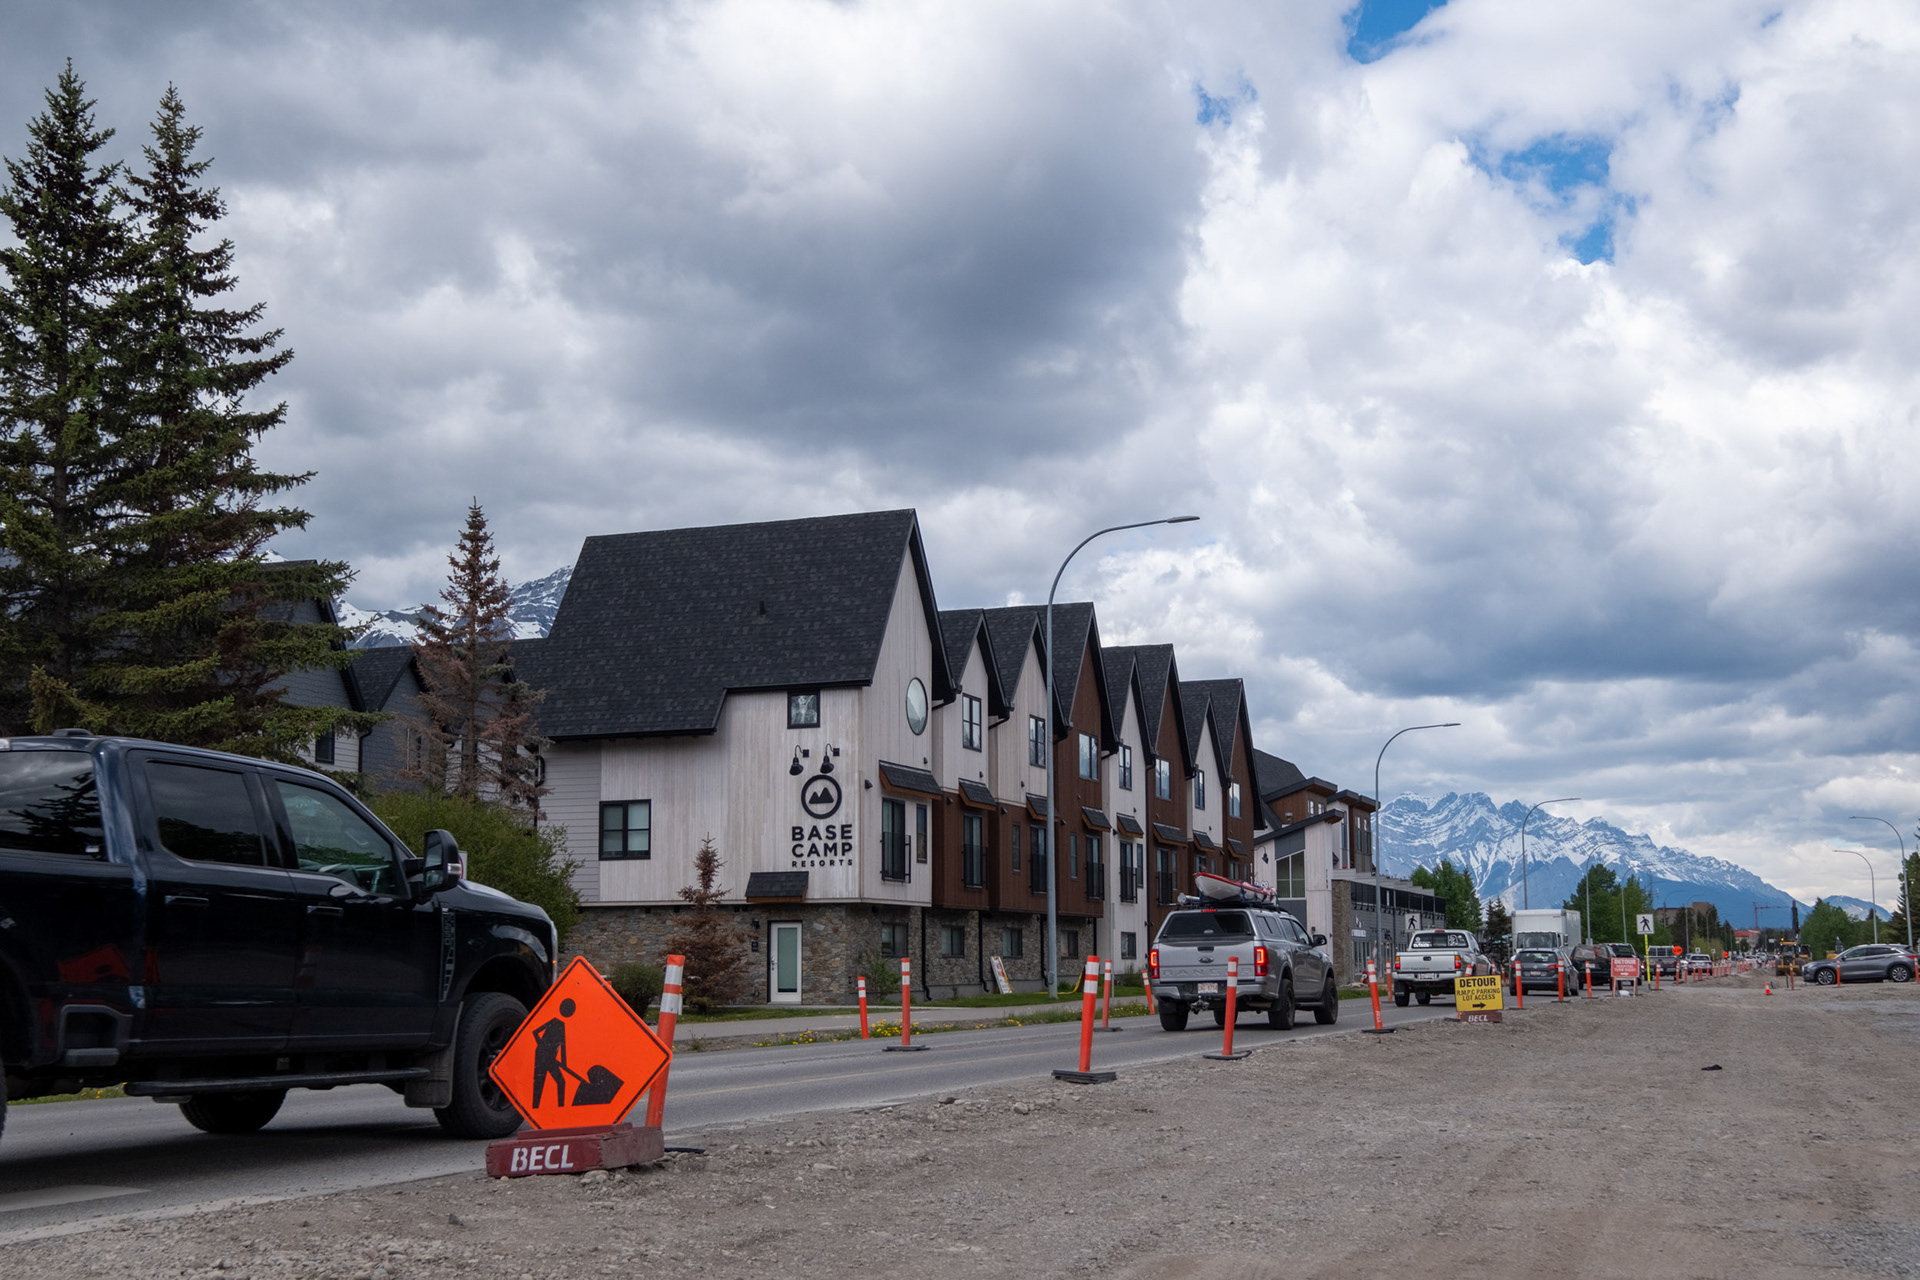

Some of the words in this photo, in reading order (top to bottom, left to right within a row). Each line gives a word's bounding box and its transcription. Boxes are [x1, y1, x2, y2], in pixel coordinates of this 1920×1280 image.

[792, 824, 853, 841] BASE
[791, 842, 853, 858] CAMP
[792, 859, 853, 868] RESORTS
[1163, 968, 1253, 977] RANGR
[1459, 977, 1496, 988] DETOUR
[1468, 1014, 1489, 1022] BECL
[510, 1144, 574, 1172] BECL
